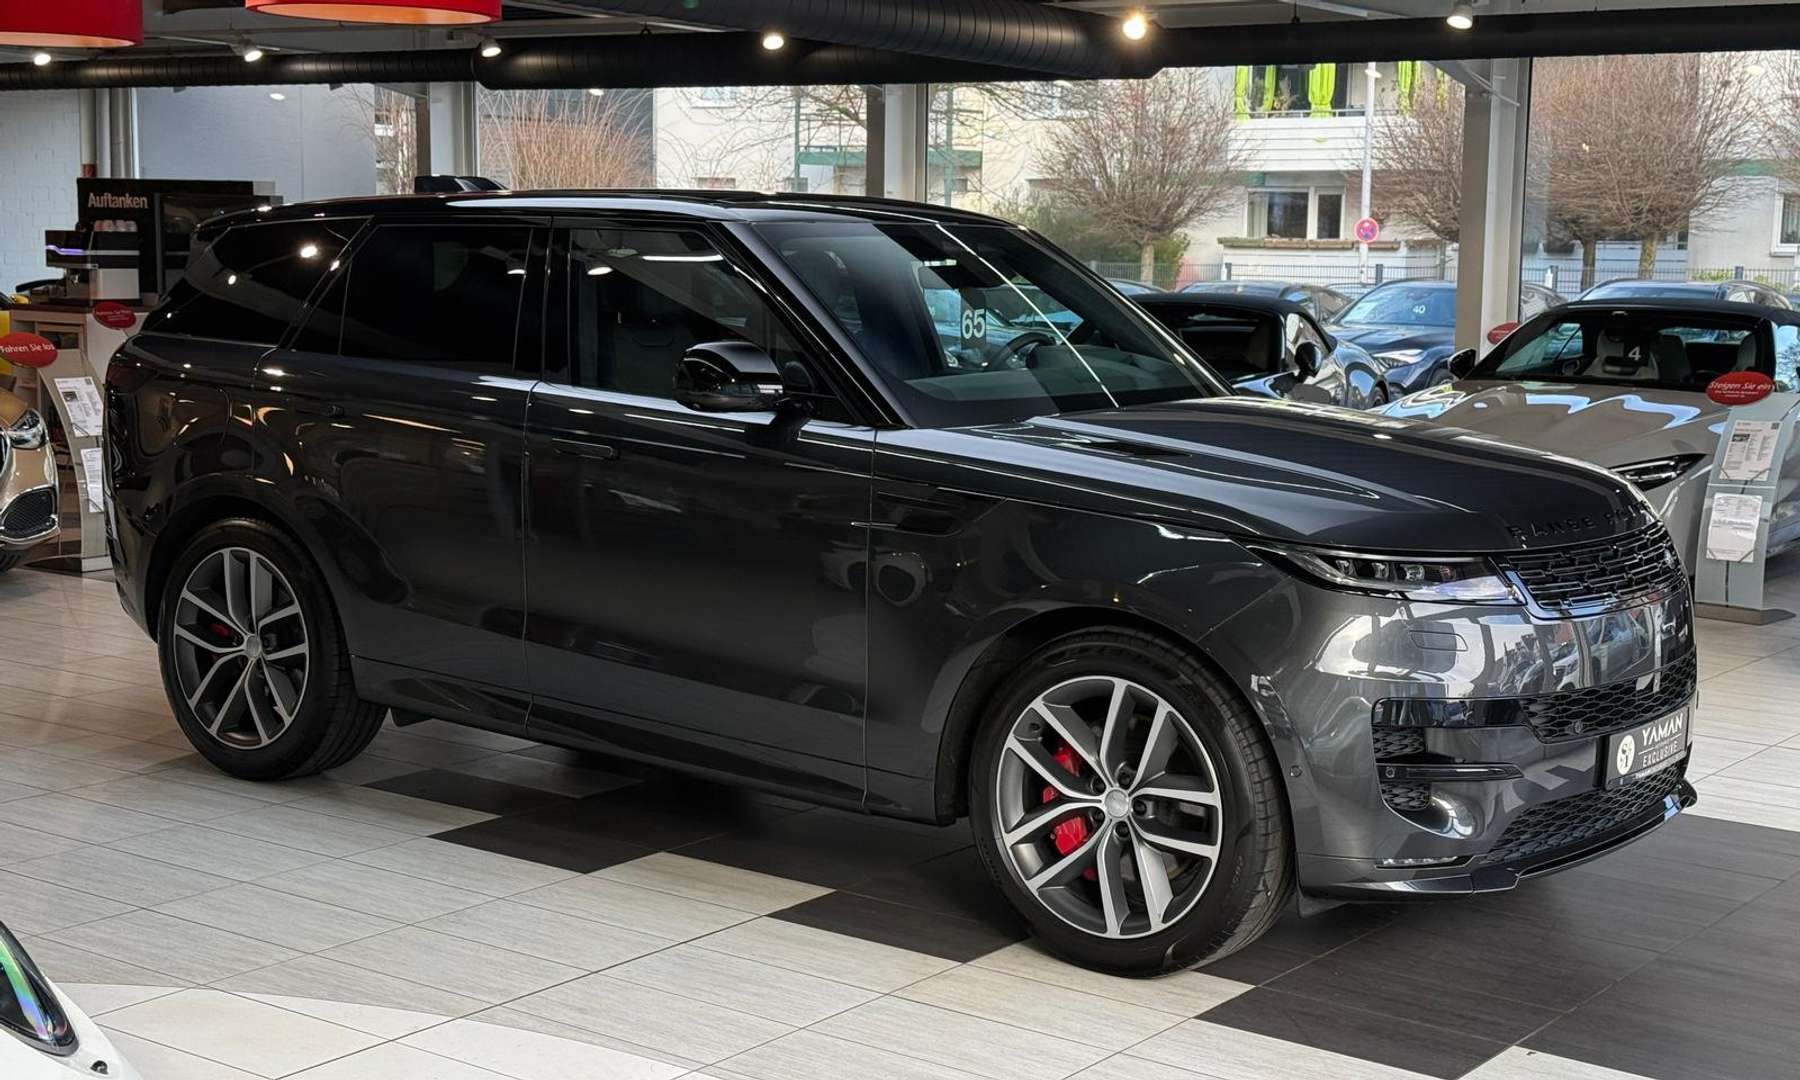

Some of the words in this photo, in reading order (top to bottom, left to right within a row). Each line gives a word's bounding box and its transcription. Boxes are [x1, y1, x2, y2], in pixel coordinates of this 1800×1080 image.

[88, 192, 148, 208] Auftanken
[1412, 304, 1426, 314] 40
[962, 309, 985, 339] 65
[1628, 346, 1641, 361] 4
[1709, 381, 1741, 391] Steigen
[1741, 382, 1757, 390] Sie
[1642, 712, 1683, 746] YAMAN
[1642, 740, 1679, 768] EXCLUSIVE
